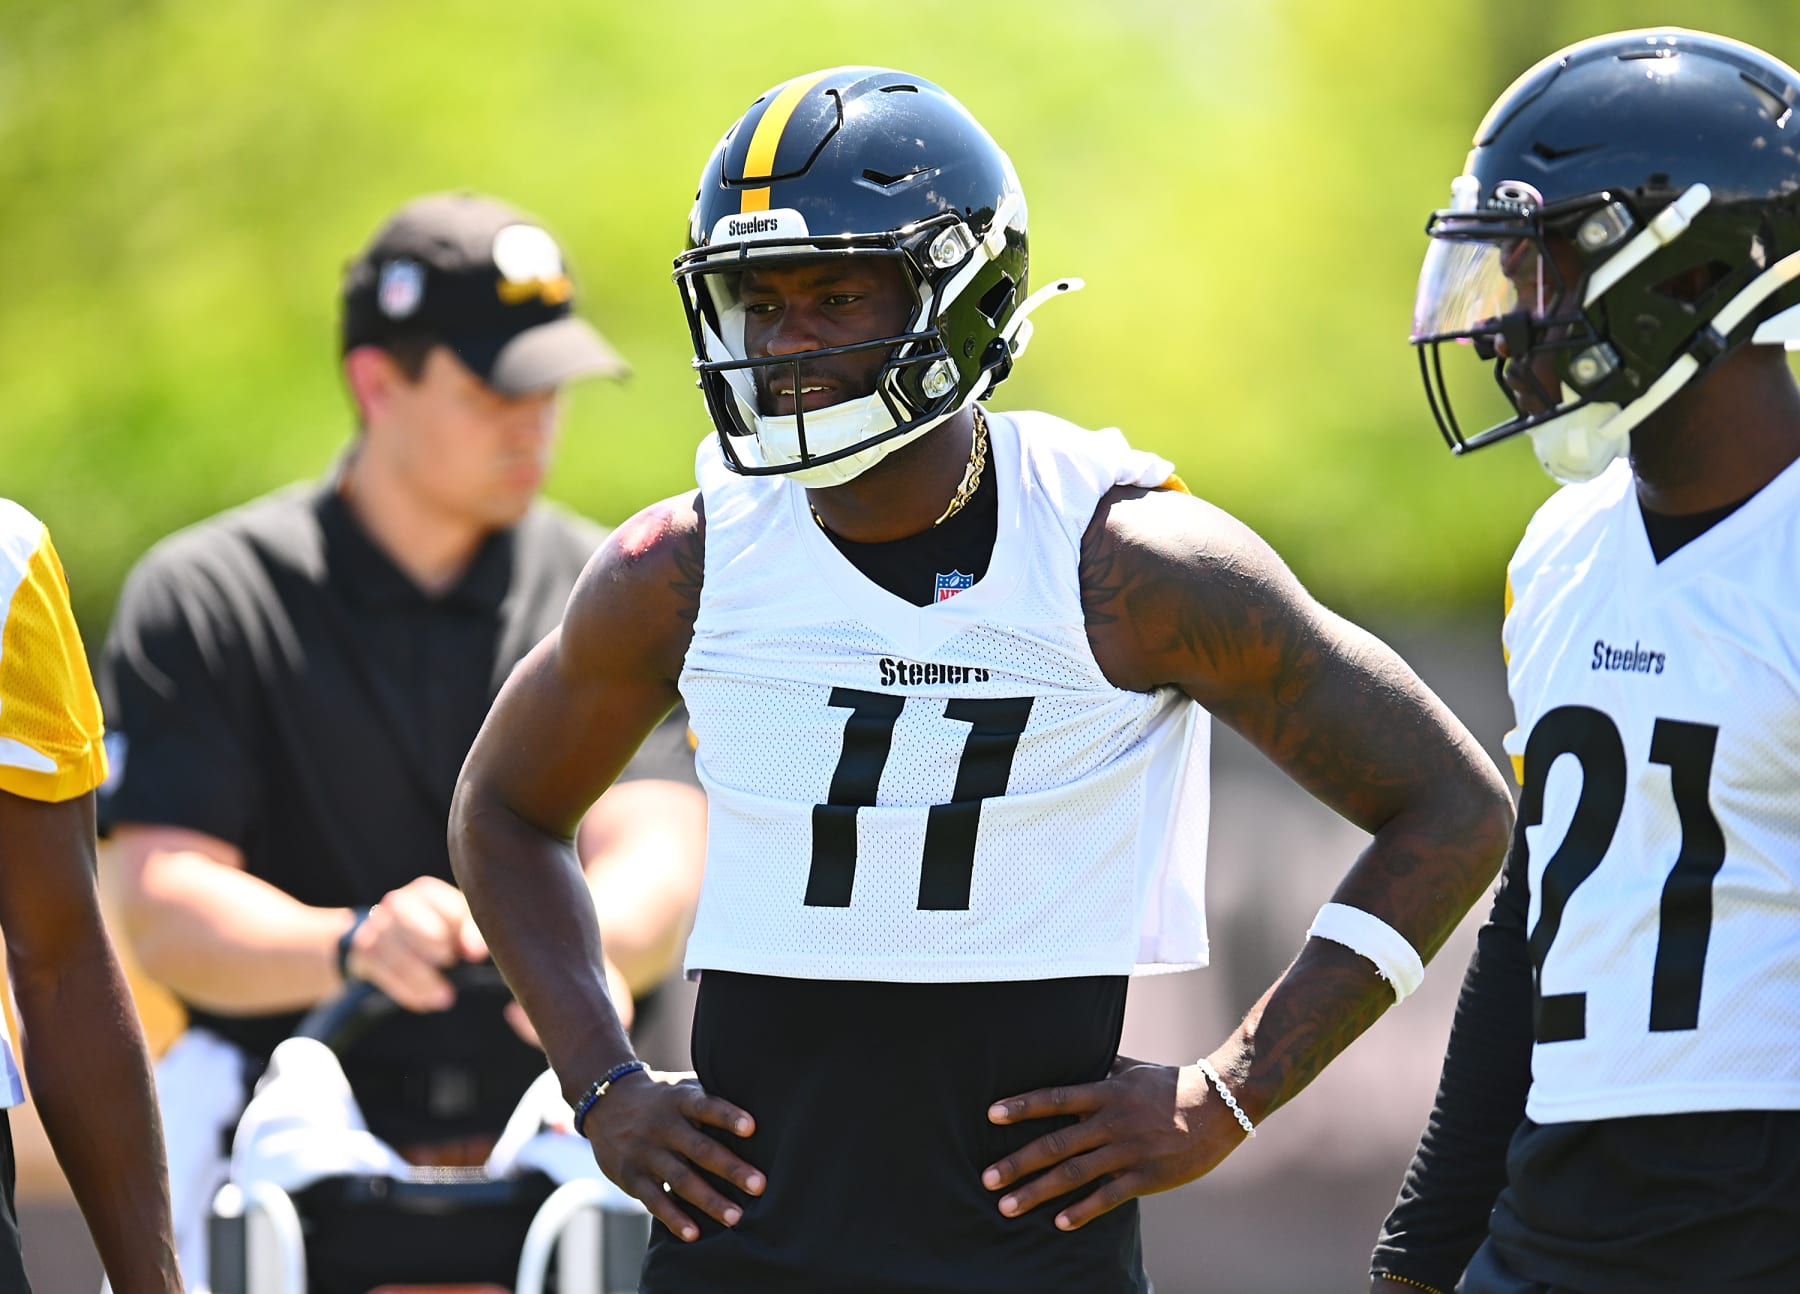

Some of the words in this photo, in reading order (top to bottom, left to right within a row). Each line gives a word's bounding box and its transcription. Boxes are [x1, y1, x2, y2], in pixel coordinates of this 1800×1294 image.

[728, 216, 778, 237] Steelers
[879, 658, 990, 686] Steelers
[1591, 639, 1666, 674] Steelers
[803, 686, 1036, 910] 11
[1523, 705, 1726, 1044] 21
